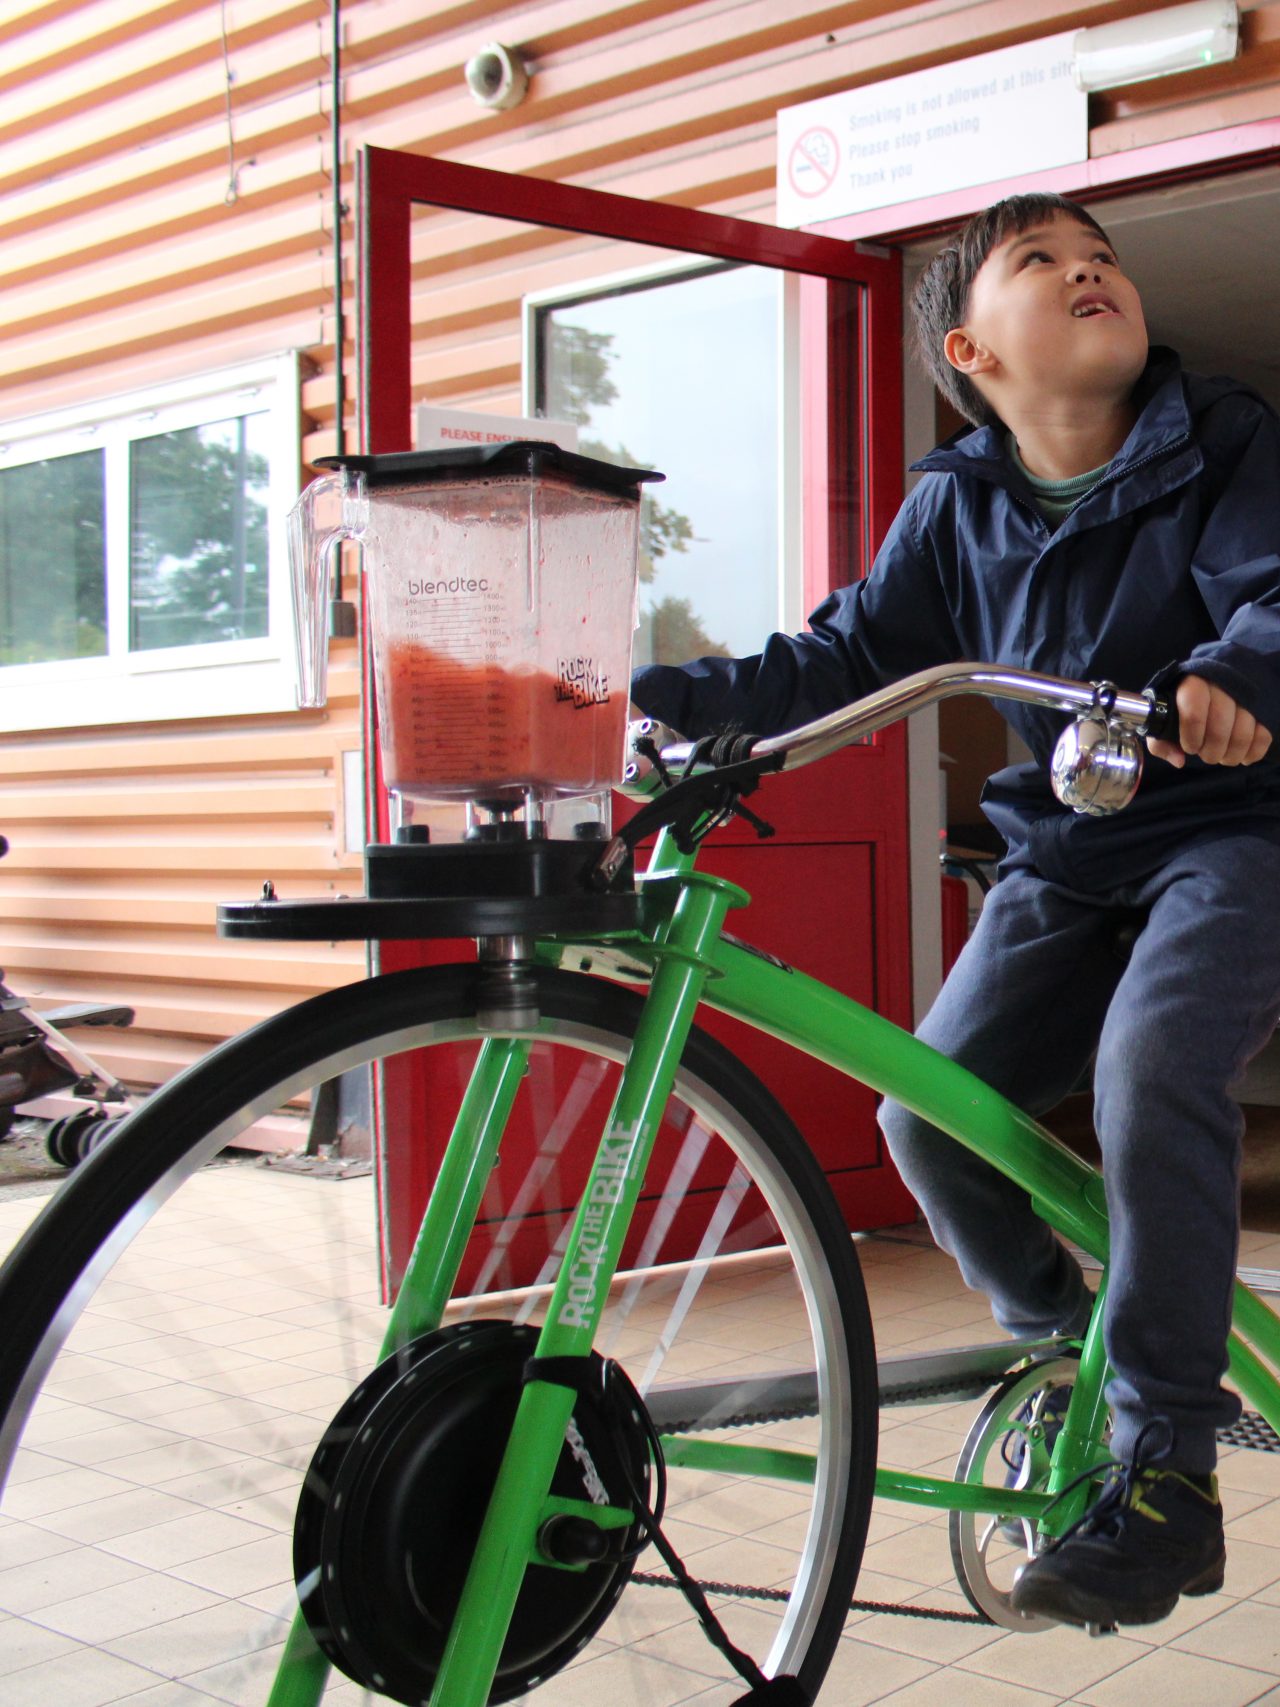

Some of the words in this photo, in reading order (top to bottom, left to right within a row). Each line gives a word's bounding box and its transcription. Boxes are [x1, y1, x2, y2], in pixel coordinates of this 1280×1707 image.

[849, 107, 901, 131] Smoking
[906, 101, 917, 116] is
[922, 93, 941, 112] not
[947, 78, 997, 106] allowed
[1002, 74, 1015, 92] at
[1020, 66, 1045, 87] this
[849, 140, 889, 160] Please
[895, 131, 921, 149] stop
[927, 116, 980, 141] smoking
[849, 167, 885, 189] Thank
[891, 162, 913, 183] you
[440, 427, 483, 442] PLEASE
[408, 576, 489, 596] blendtec
[556, 656, 594, 682] ROCK
[573, 673, 610, 709] BIKE
[590, 1118, 639, 1205] BIKE
[578, 1205, 606, 1246] THE
[558, 1243, 609, 1330] ROCK
